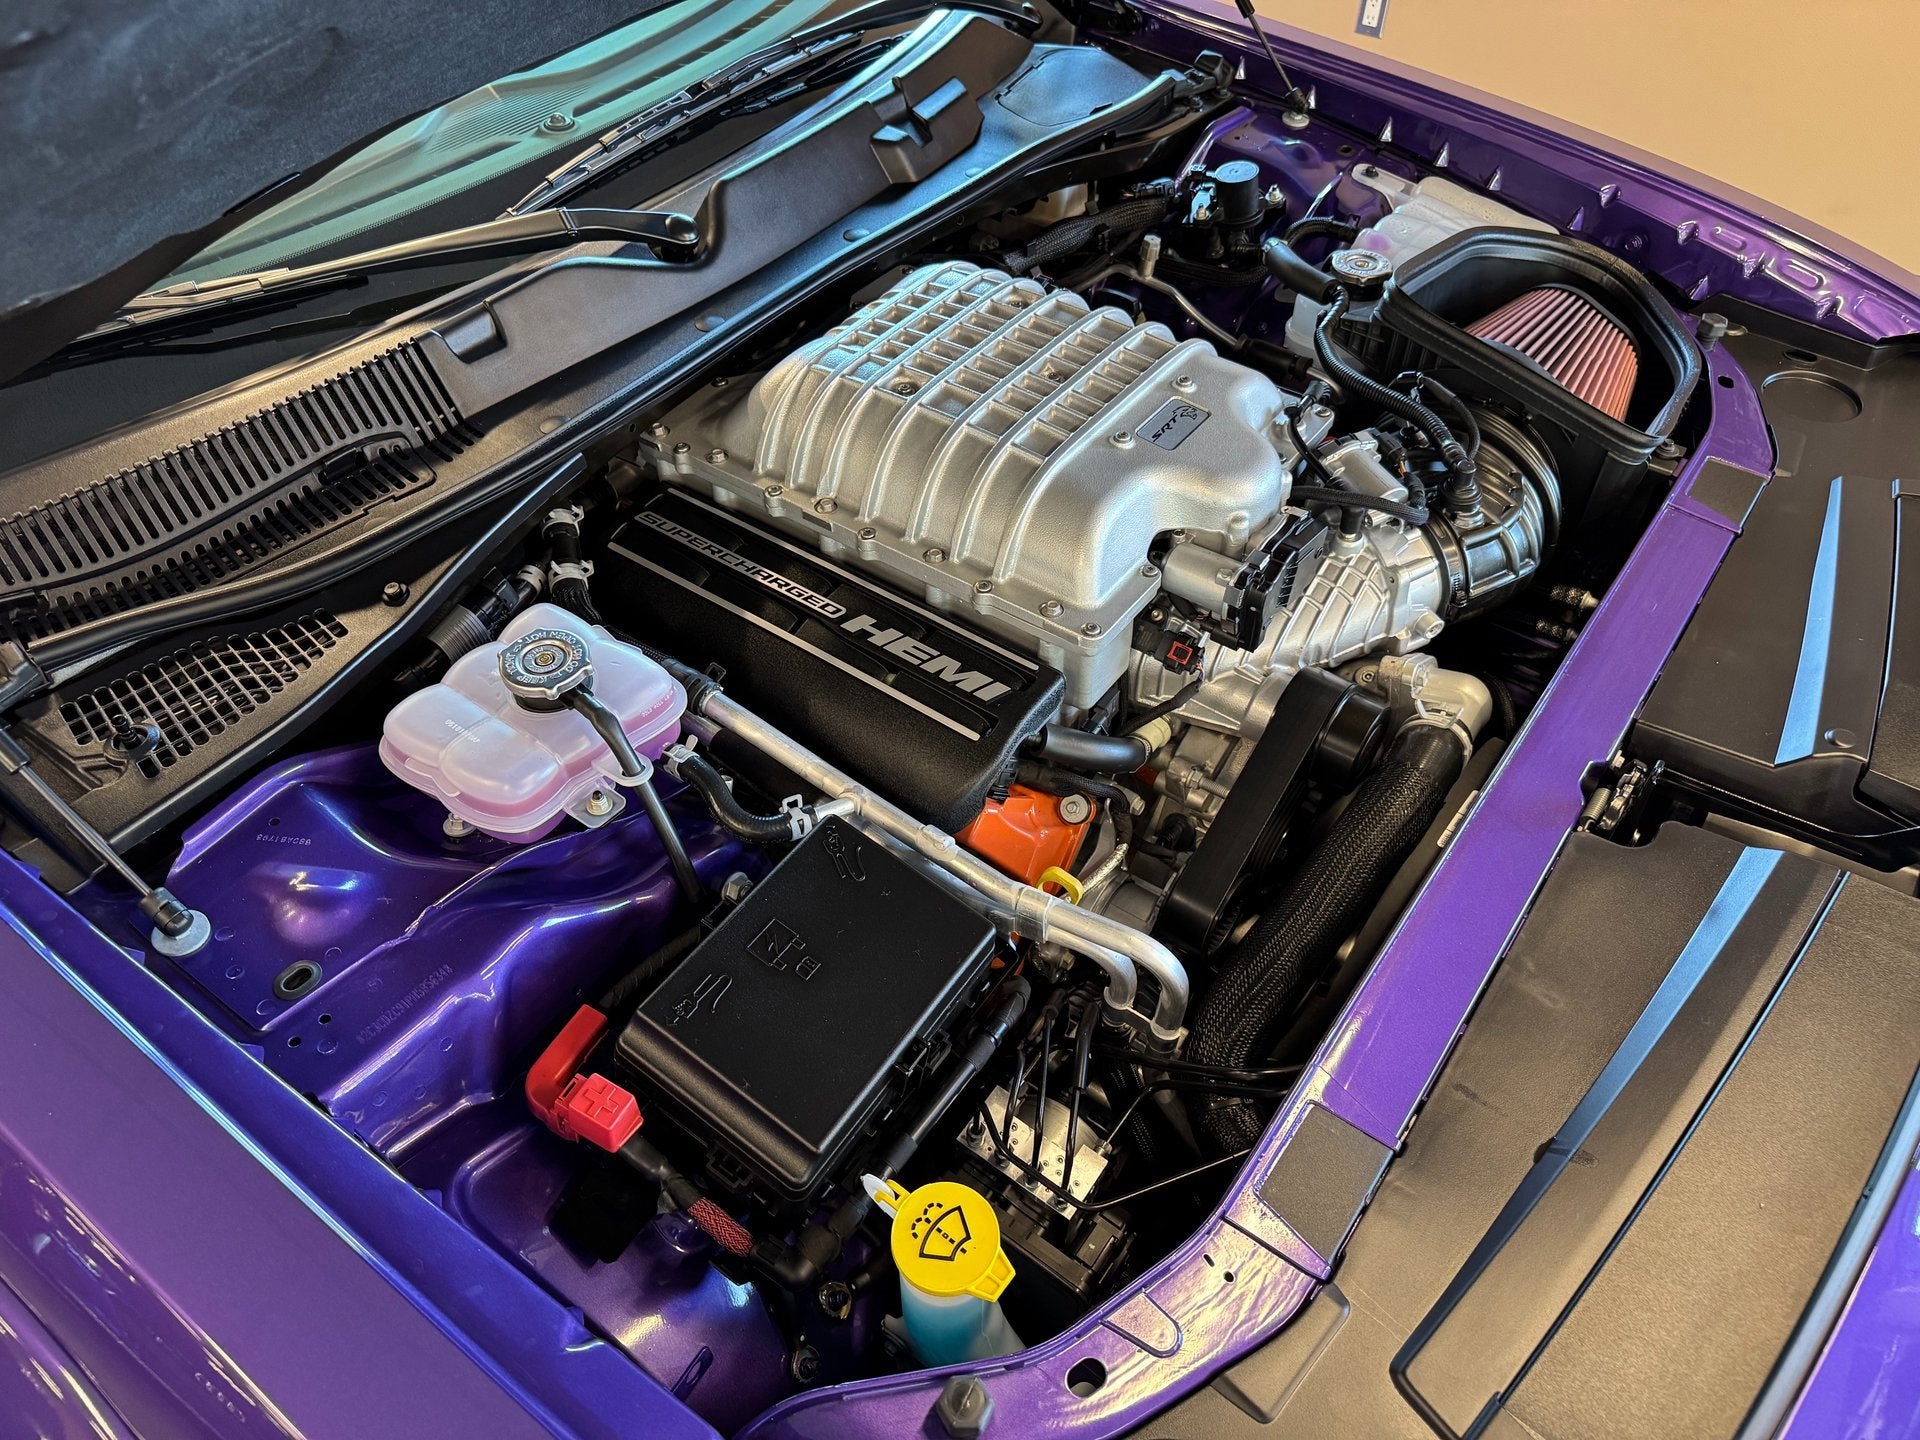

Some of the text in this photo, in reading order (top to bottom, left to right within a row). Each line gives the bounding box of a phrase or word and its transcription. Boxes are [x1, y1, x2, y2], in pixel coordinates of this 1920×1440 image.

[1151, 414, 1178, 442] SRT
[637, 512, 1012, 701] SUPERCHARGED HEMI
[524, 631, 547, 644] HOT
[549, 631, 577, 645] OPEN
